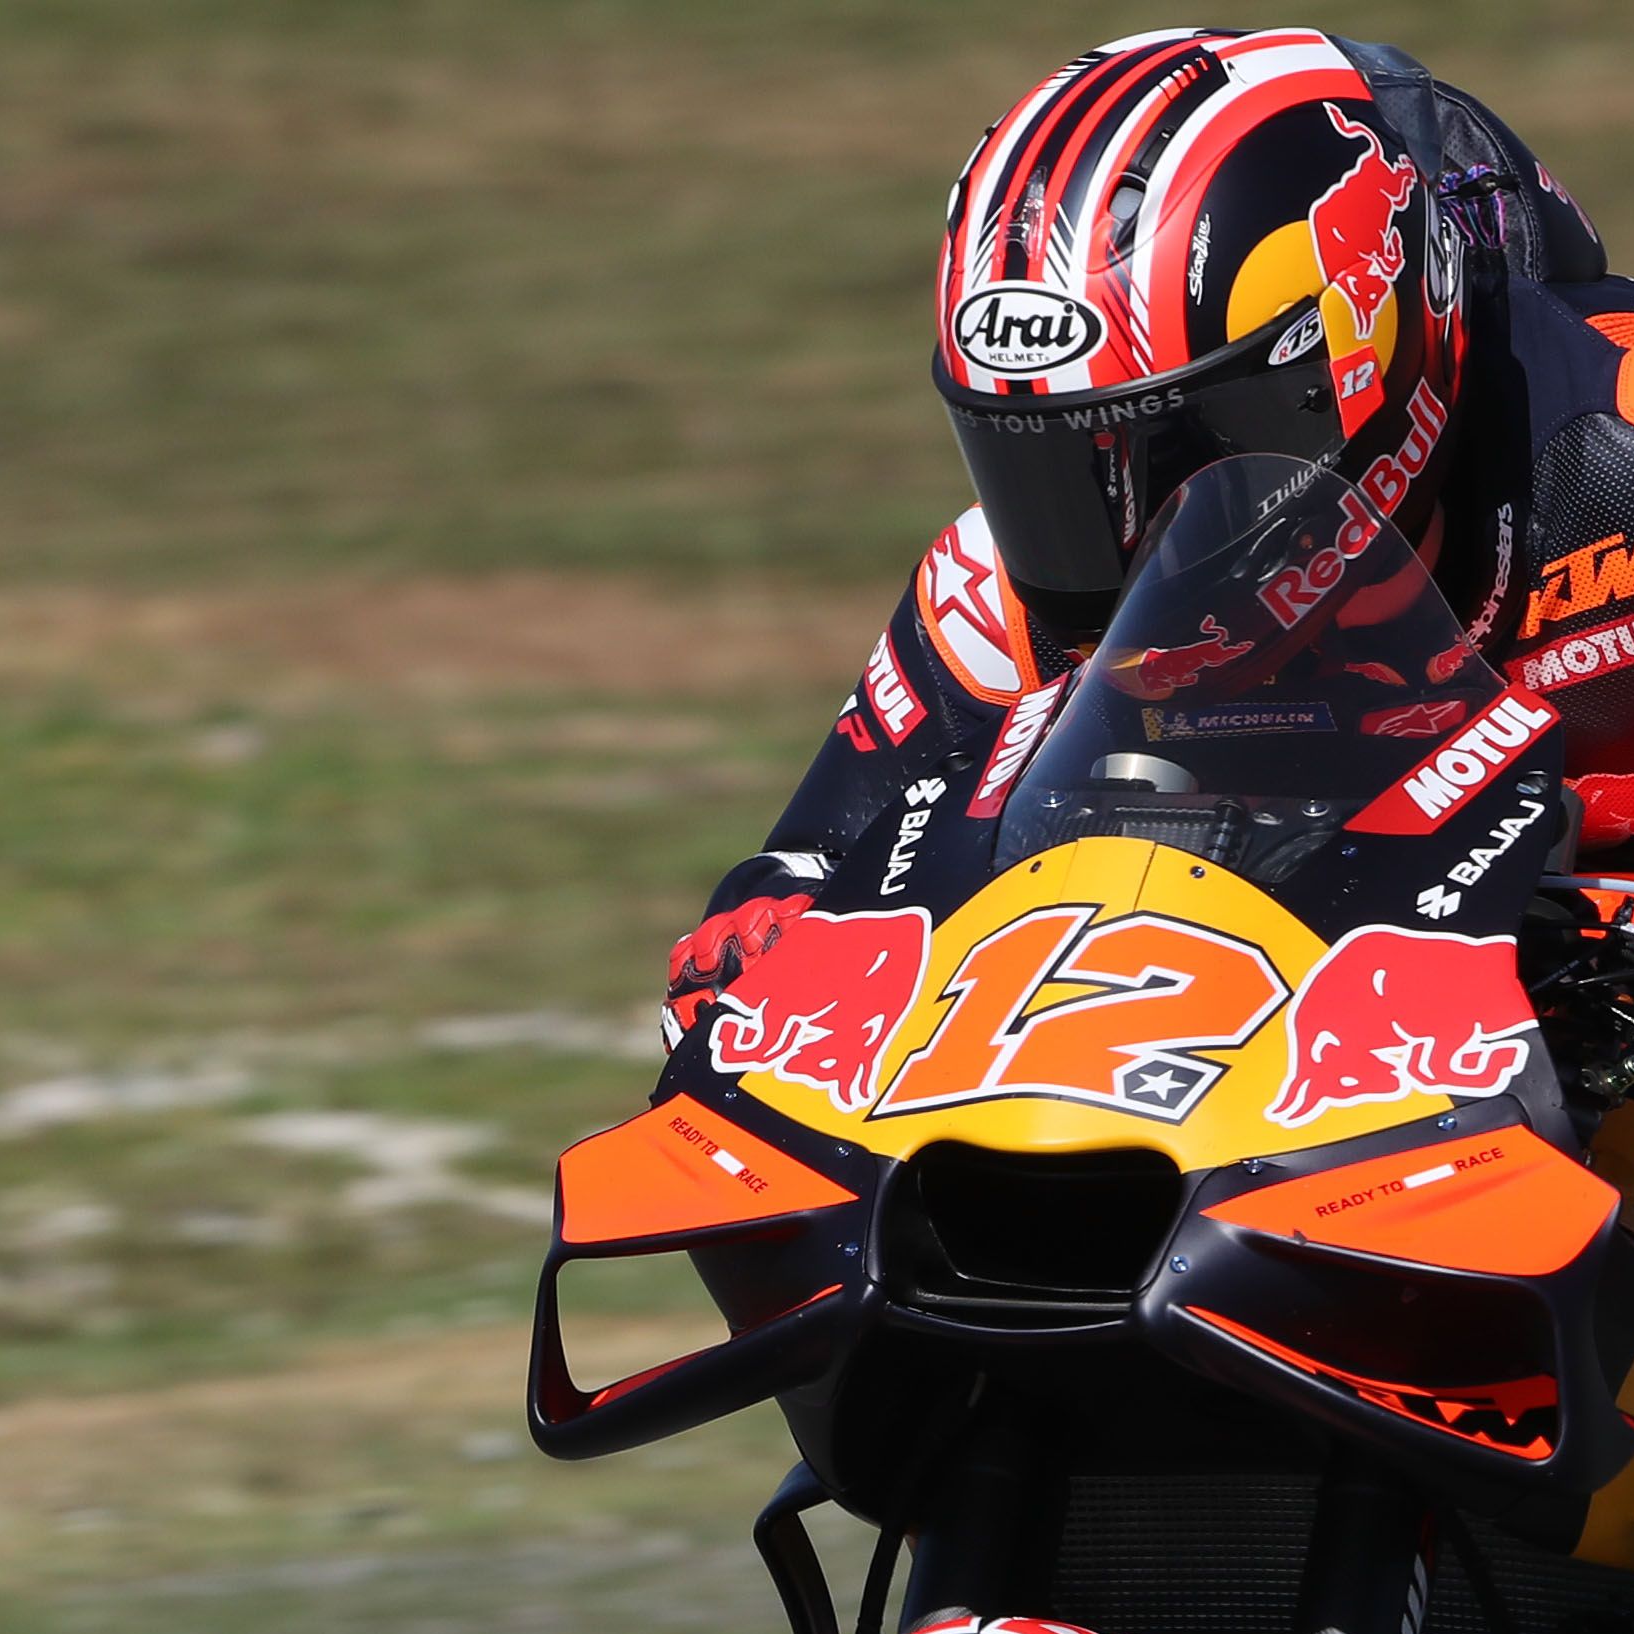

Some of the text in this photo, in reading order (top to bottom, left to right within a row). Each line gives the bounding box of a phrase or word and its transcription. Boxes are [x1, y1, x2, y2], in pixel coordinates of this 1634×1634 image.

[960, 297, 1080, 348] Arai
[988, 352, 1044, 363] HELMET
[987, 412, 1046, 433] YOU
[1063, 387, 1185, 430] WINGS
[1340, 361, 1376, 400] 12
[1255, 487, 1383, 630] Red
[1356, 376, 1448, 521] Bull
[977, 682, 1062, 801] MOTUL
[1402, 696, 1553, 821] MOTUL
[879, 808, 933, 897] BAJAJ
[1446, 799, 1546, 887] BAJAJ
[863, 903, 1296, 1127] 12
[668, 1117, 768, 1194] READY TO RACE
[1316, 1147, 1504, 1217] READY TO RACE
